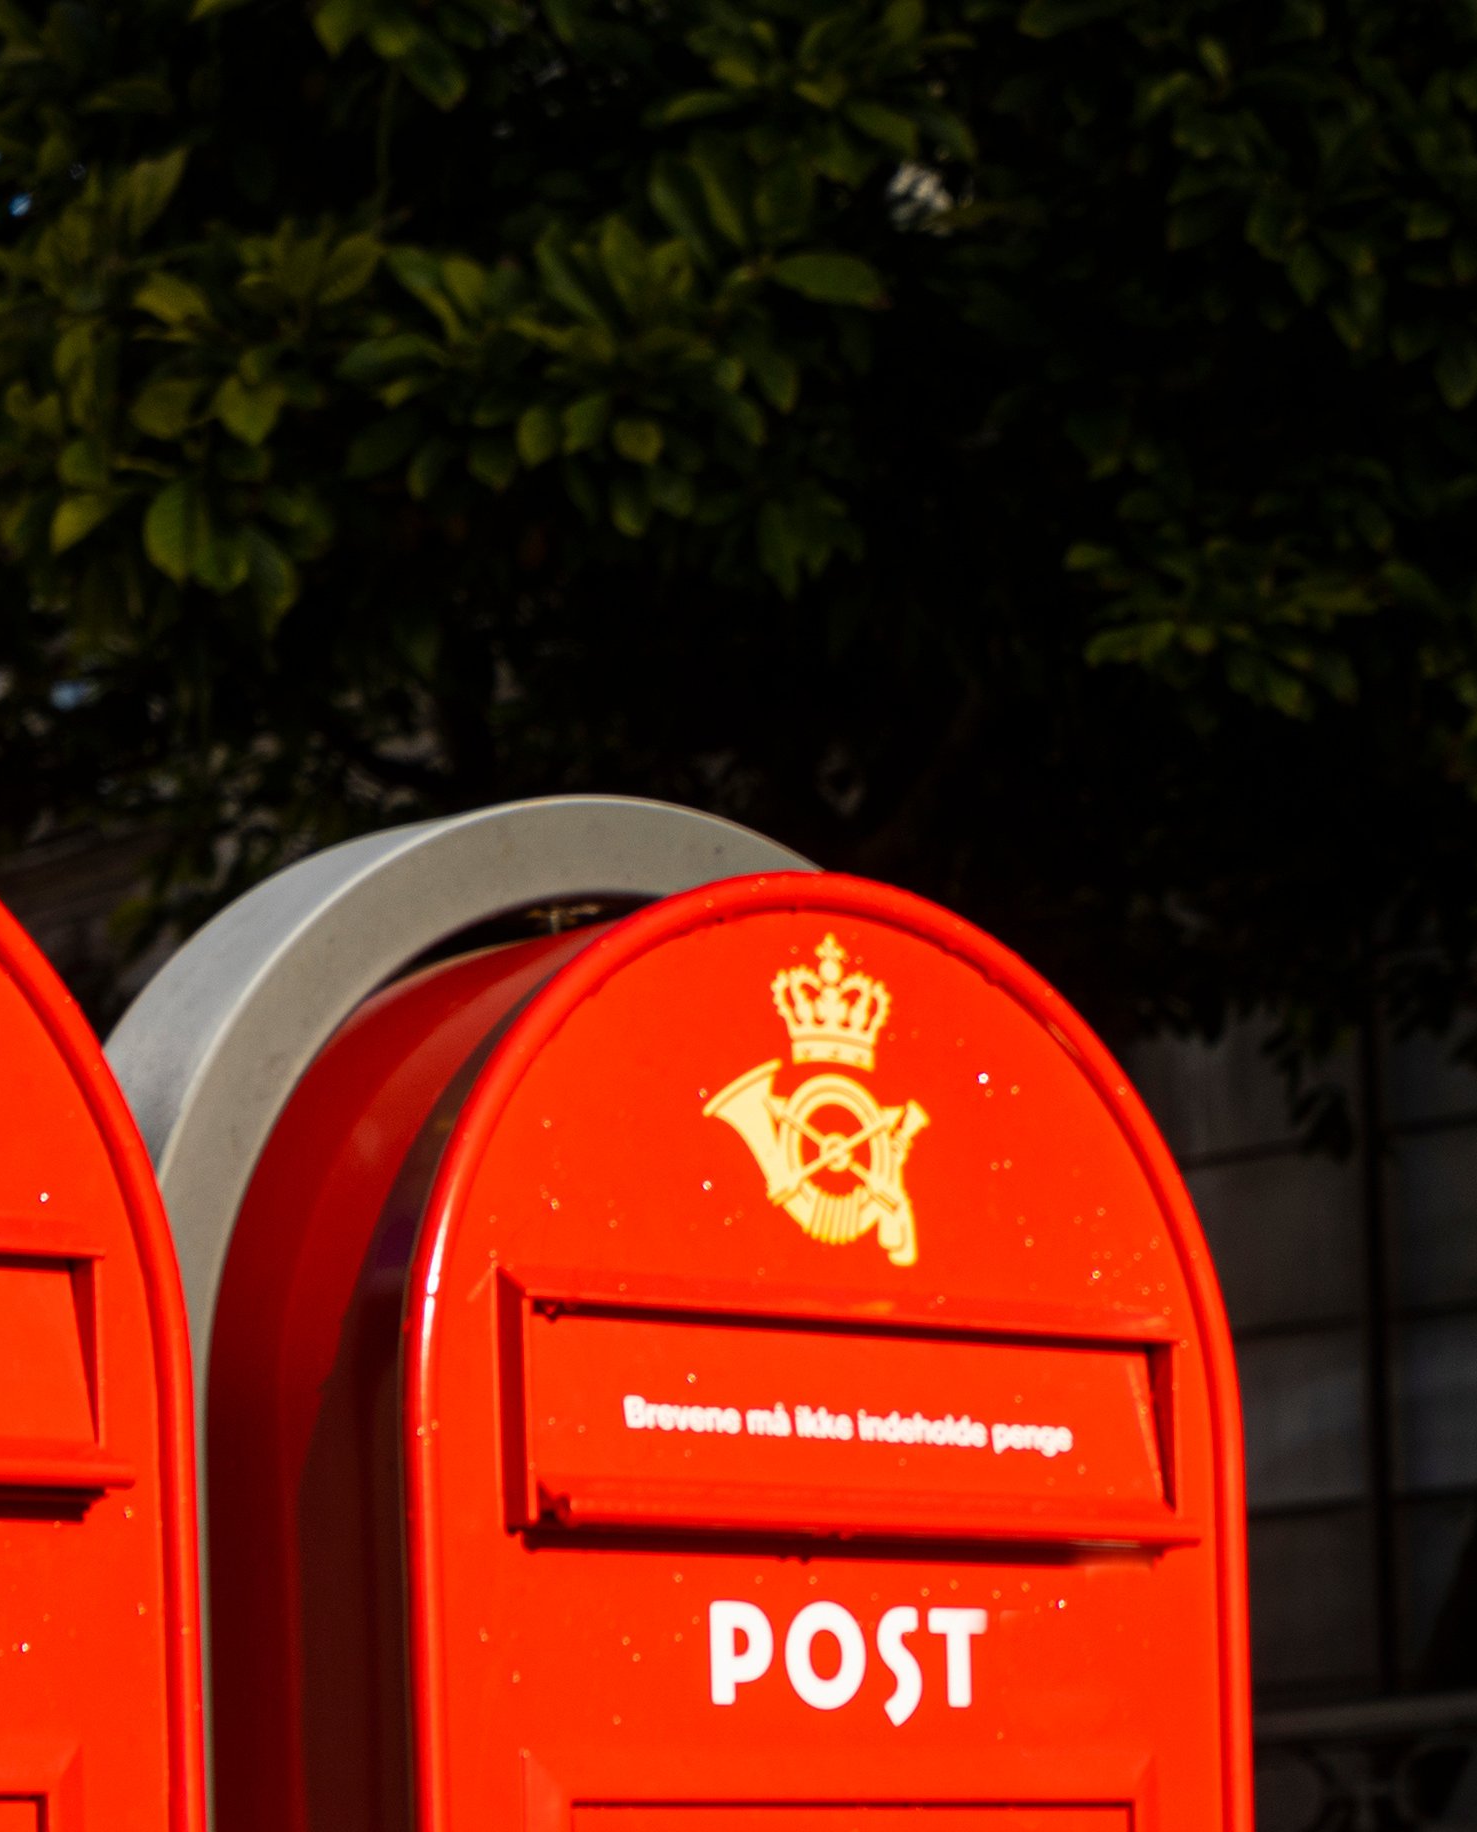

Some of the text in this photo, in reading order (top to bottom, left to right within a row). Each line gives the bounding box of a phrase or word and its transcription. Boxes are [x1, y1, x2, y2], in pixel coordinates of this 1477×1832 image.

[623, 1394, 1073, 1458] Brevene må ikke indeholde penge
[708, 1599, 988, 1727] POST
